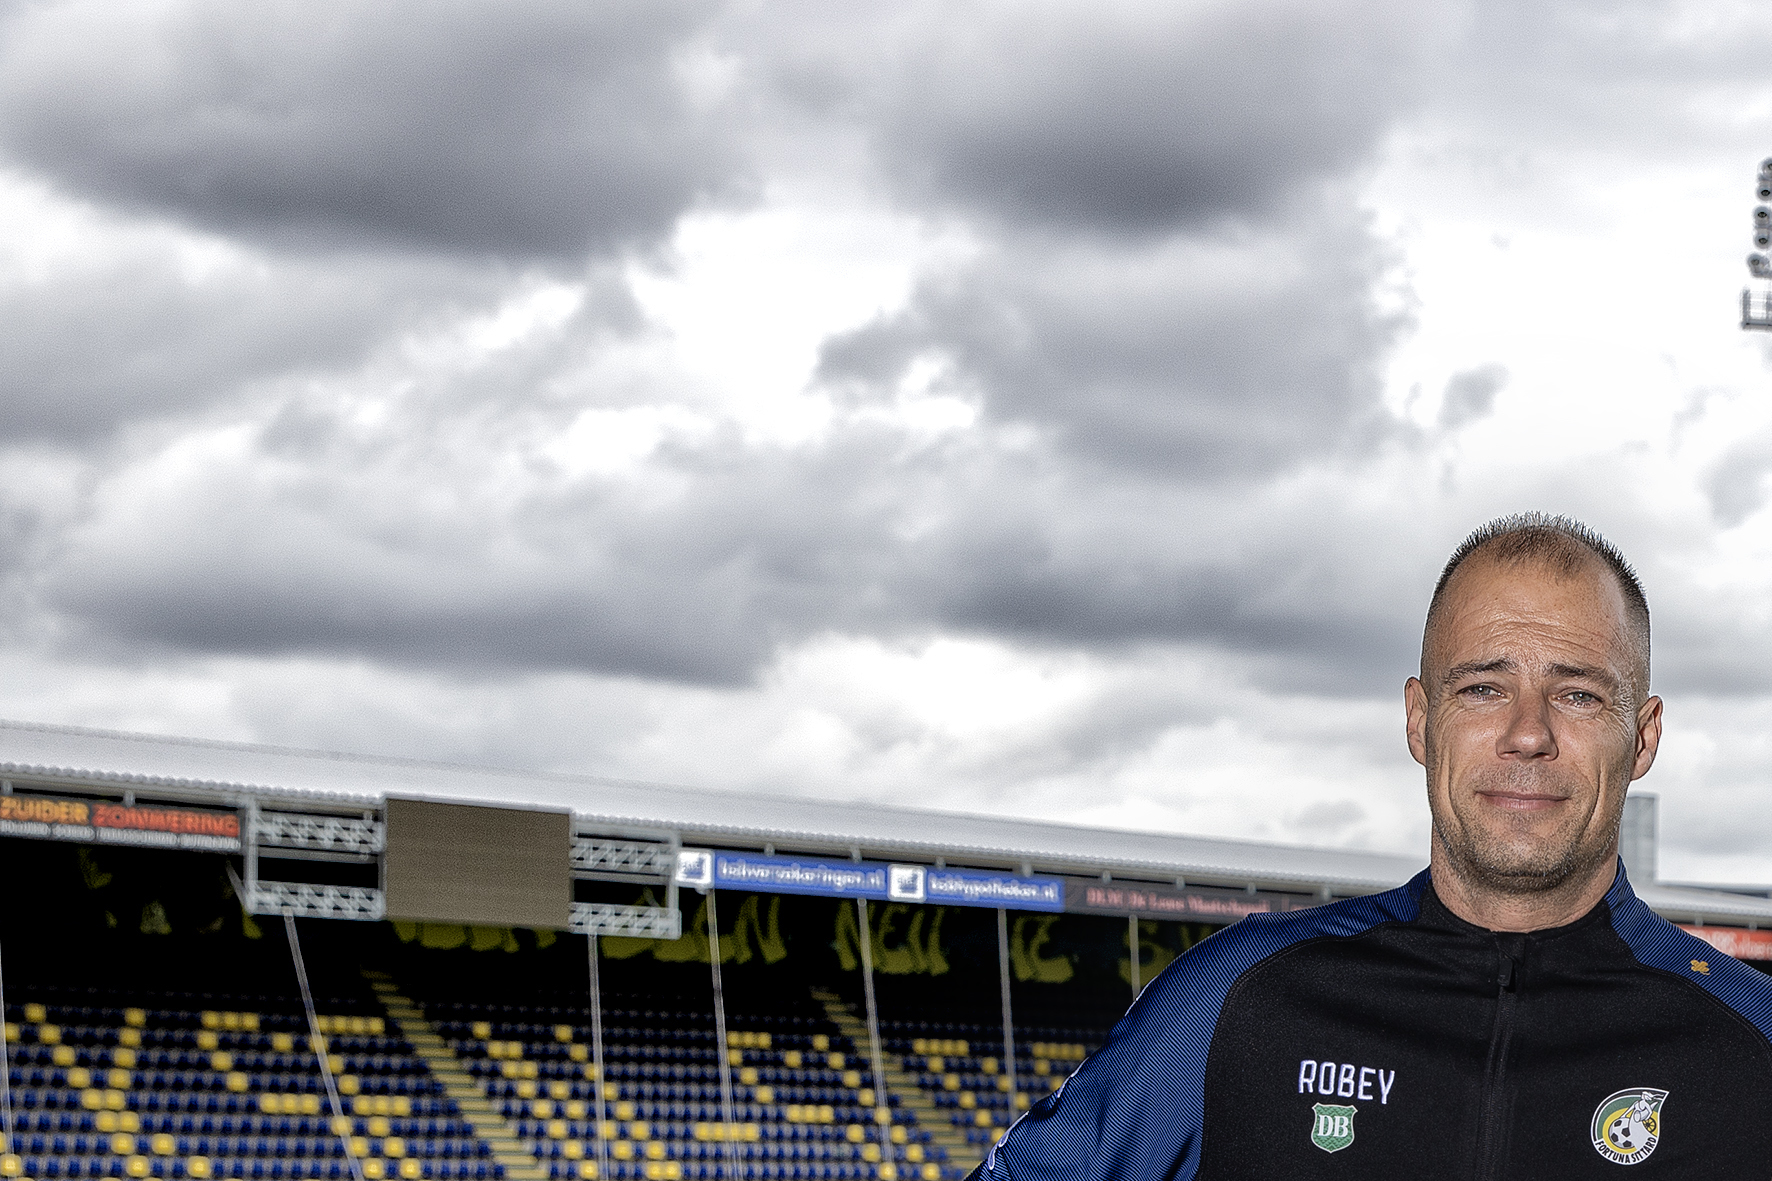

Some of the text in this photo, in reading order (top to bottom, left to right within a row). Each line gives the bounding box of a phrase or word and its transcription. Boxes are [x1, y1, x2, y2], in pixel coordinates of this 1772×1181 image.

[1299, 1060, 1395, 1105] ROBEY
[1317, 1114, 1349, 1138] DB
[1595, 1136, 1657, 1163] FORTUNA SITTARD
